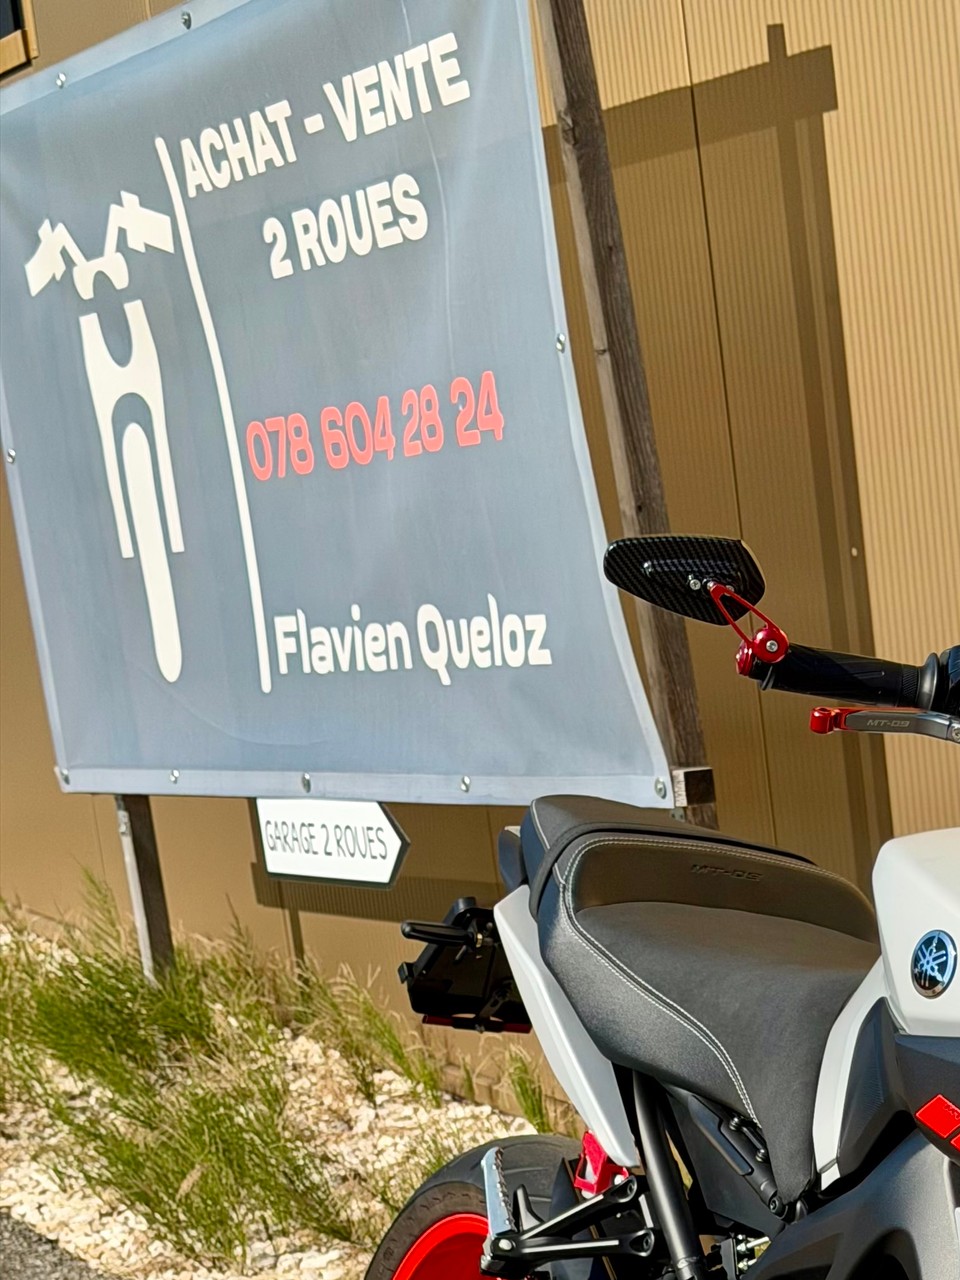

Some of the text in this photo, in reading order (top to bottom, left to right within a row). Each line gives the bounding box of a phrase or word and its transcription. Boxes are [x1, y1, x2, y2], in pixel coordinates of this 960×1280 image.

[180, 100, 297, 198] ACHAT
[323, 32, 471, 142] VENTE
[263, 174, 428, 279] 2 ROUES
[246, 371, 504, 481] 078 604 28 24
[274, 593, 552, 686] Flavien Queloz
[866, 719, 910, 728] MT-09
[265, 820, 388, 860] GARAGE 2 ROUES
